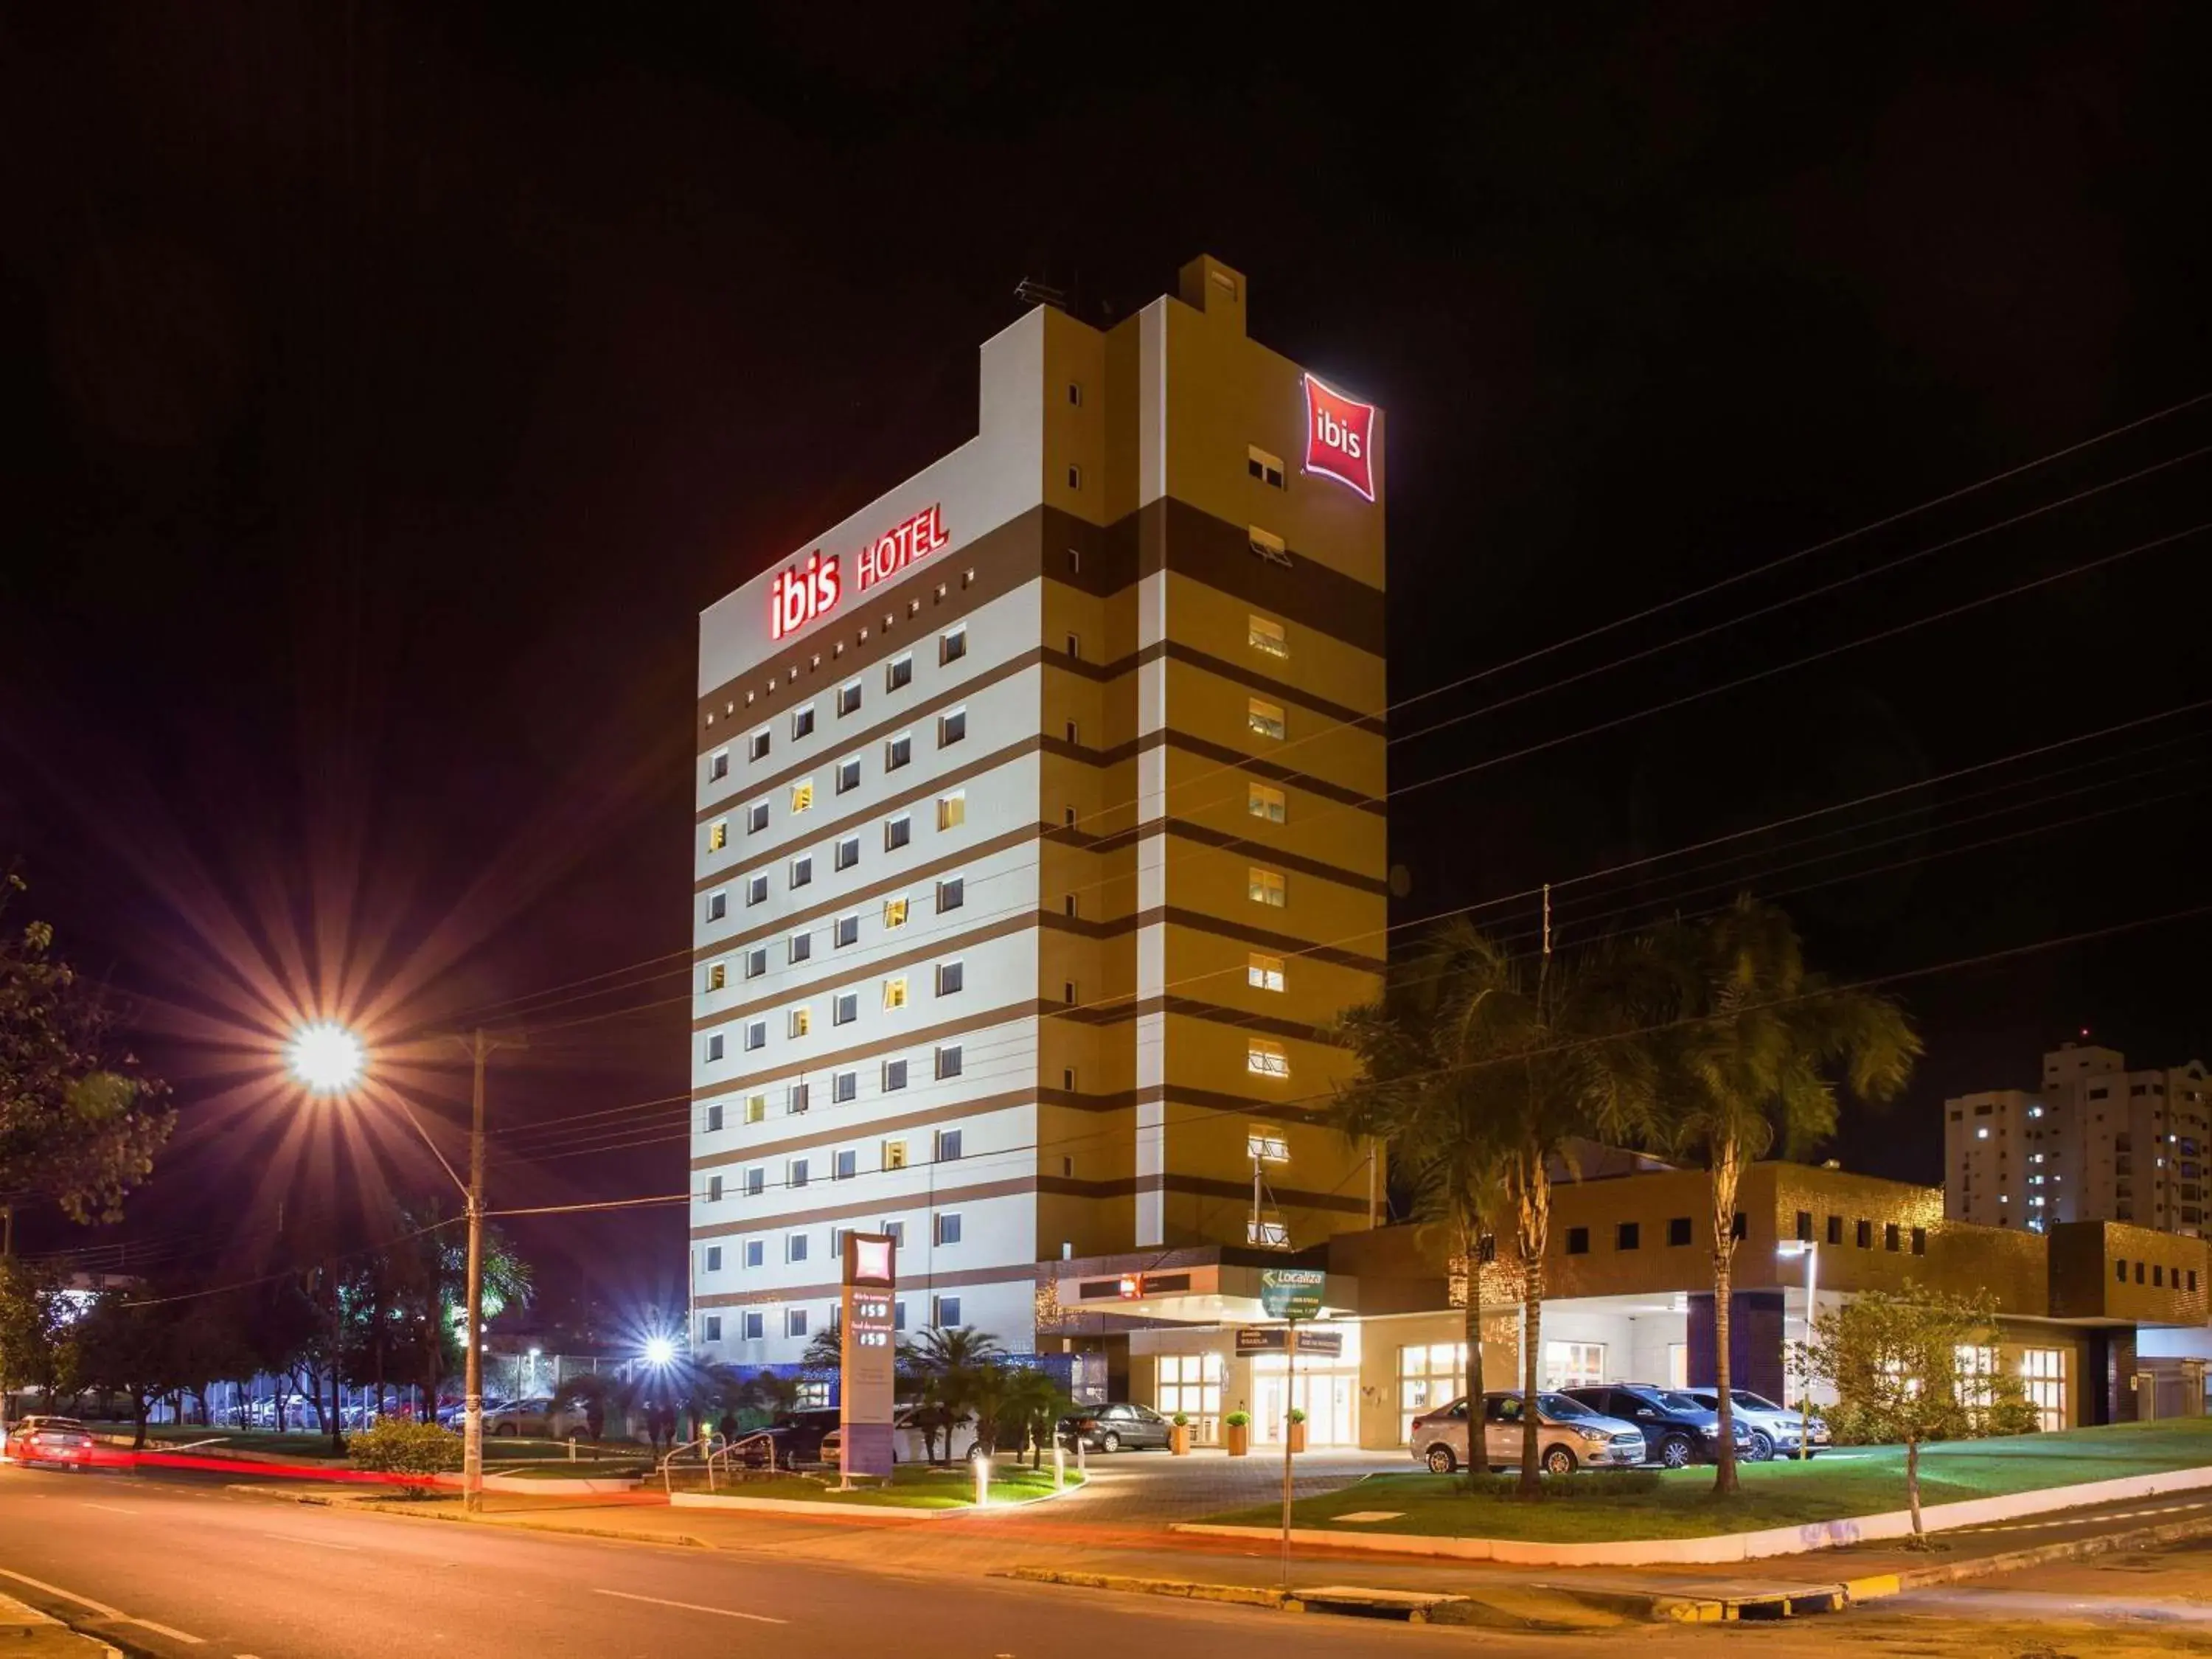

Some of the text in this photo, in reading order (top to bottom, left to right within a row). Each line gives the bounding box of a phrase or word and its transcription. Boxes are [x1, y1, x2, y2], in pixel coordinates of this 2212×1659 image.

[1317, 407, 1361, 459] ibis
[771, 504, 948, 640] ibis HOTEL
[1278, 1270, 1322, 1284] Localiza
